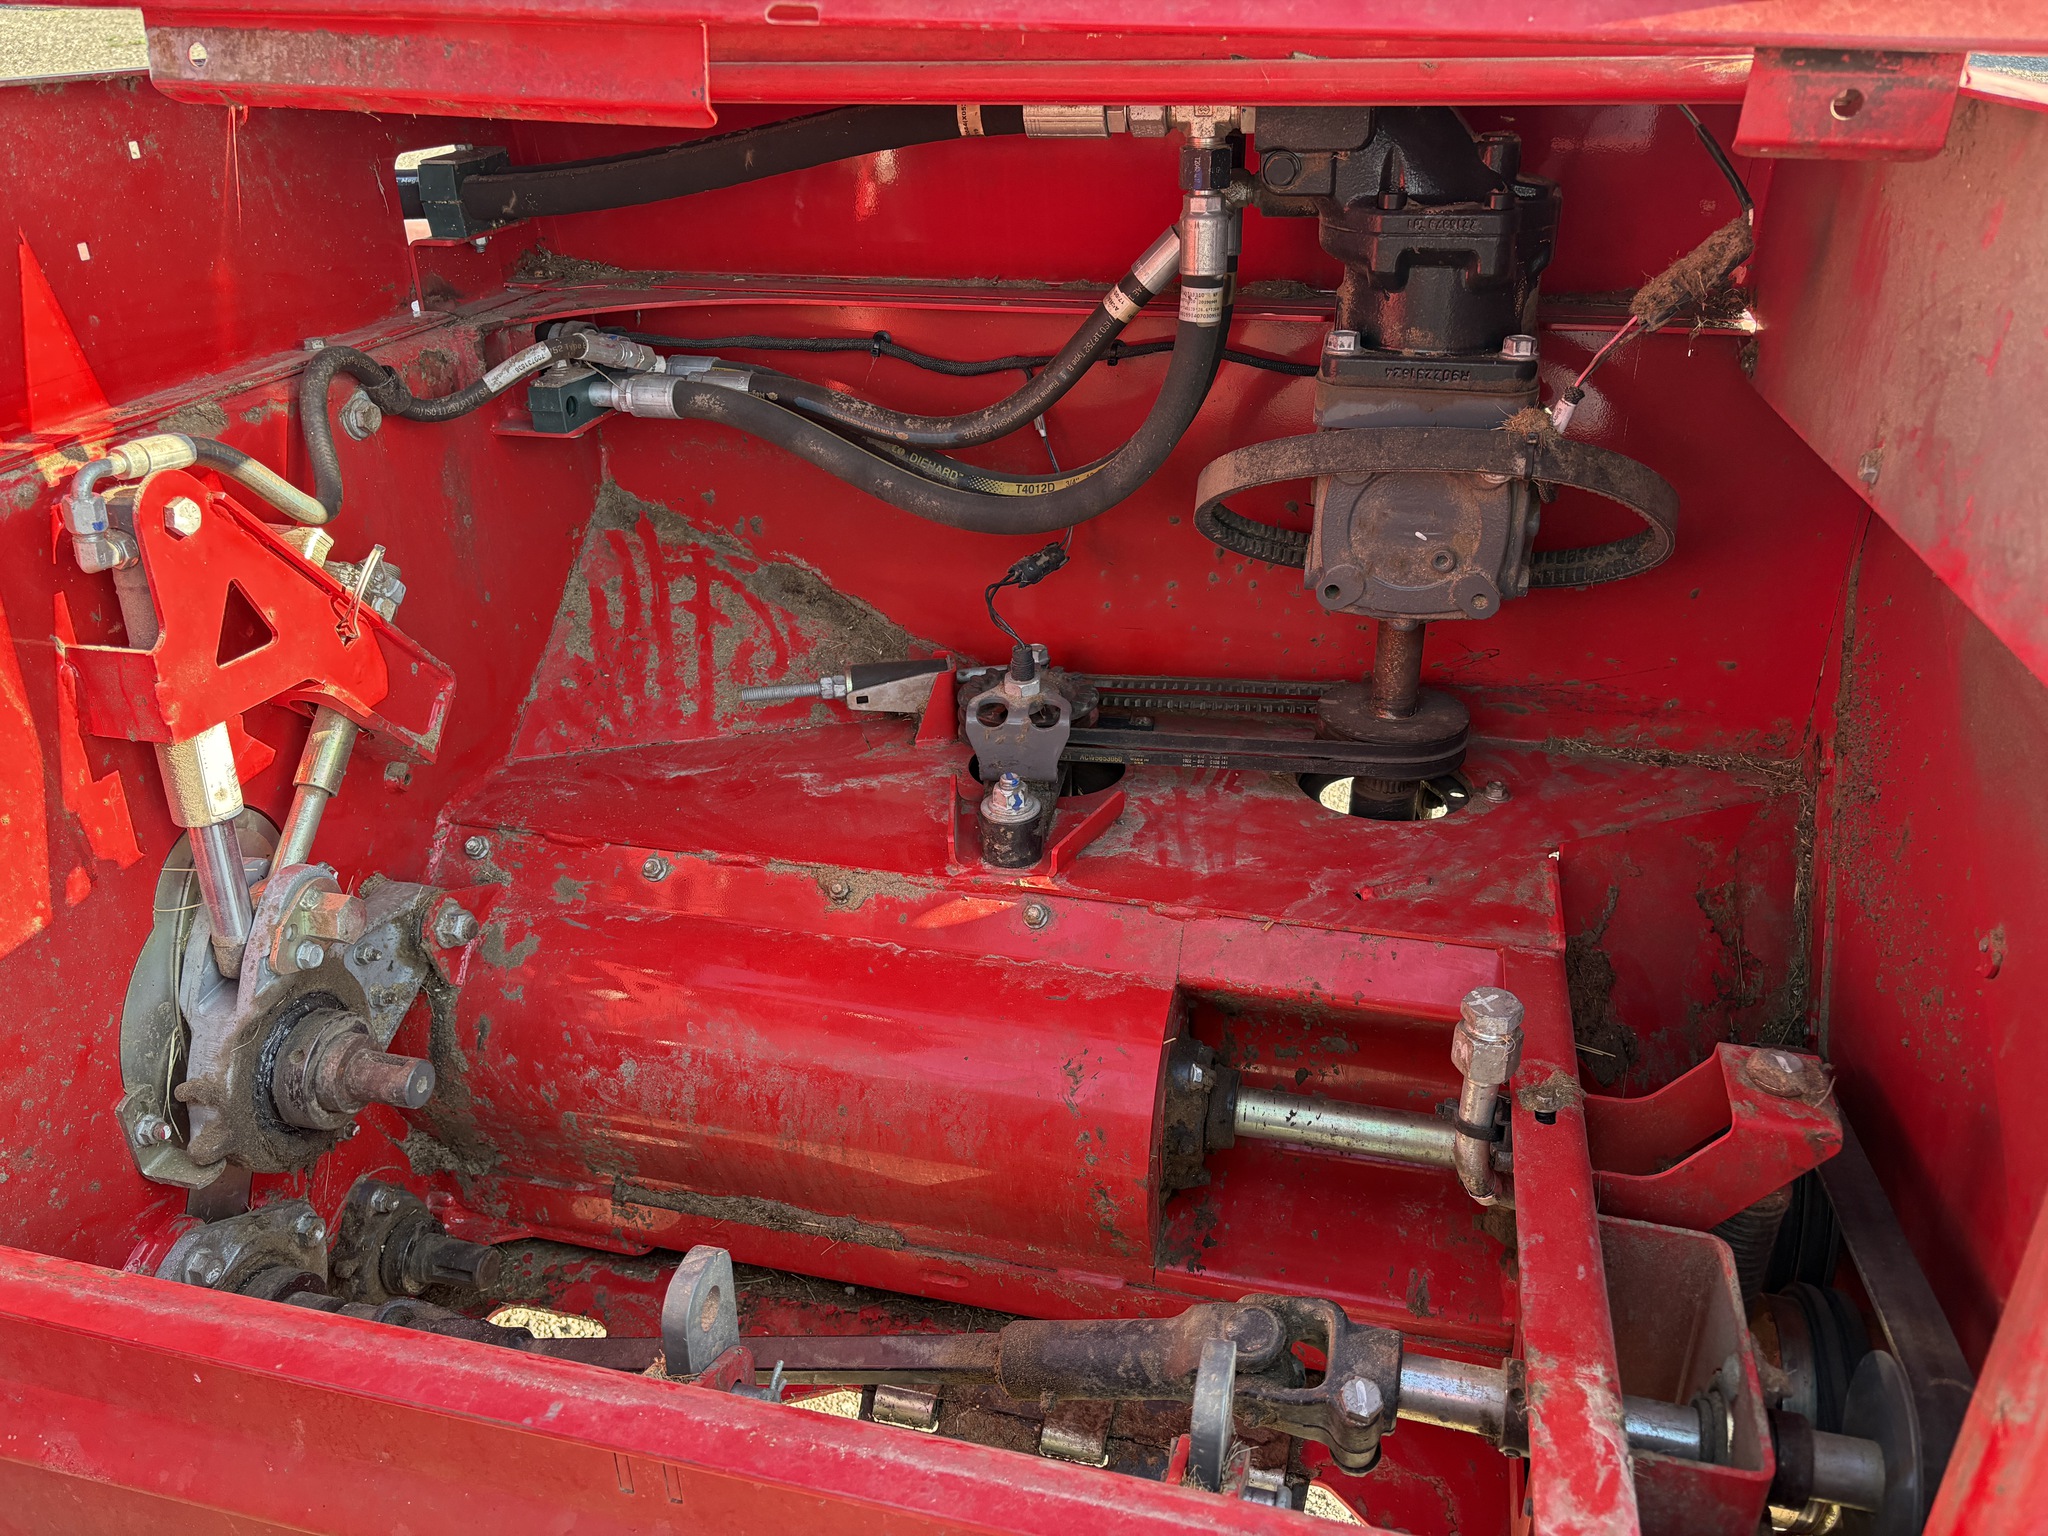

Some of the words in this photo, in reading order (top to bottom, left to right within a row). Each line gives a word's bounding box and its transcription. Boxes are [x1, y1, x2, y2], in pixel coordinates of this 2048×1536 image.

[1099, 320, 1112, 334] ISO
[1071, 350, 1087, 366] Type
[1066, 364, 1075, 372] B
[1040, 379, 1060, 398] Flame
[992, 416, 1013, 431] MSHA
[1015, 482, 1056, 495] T4012D
